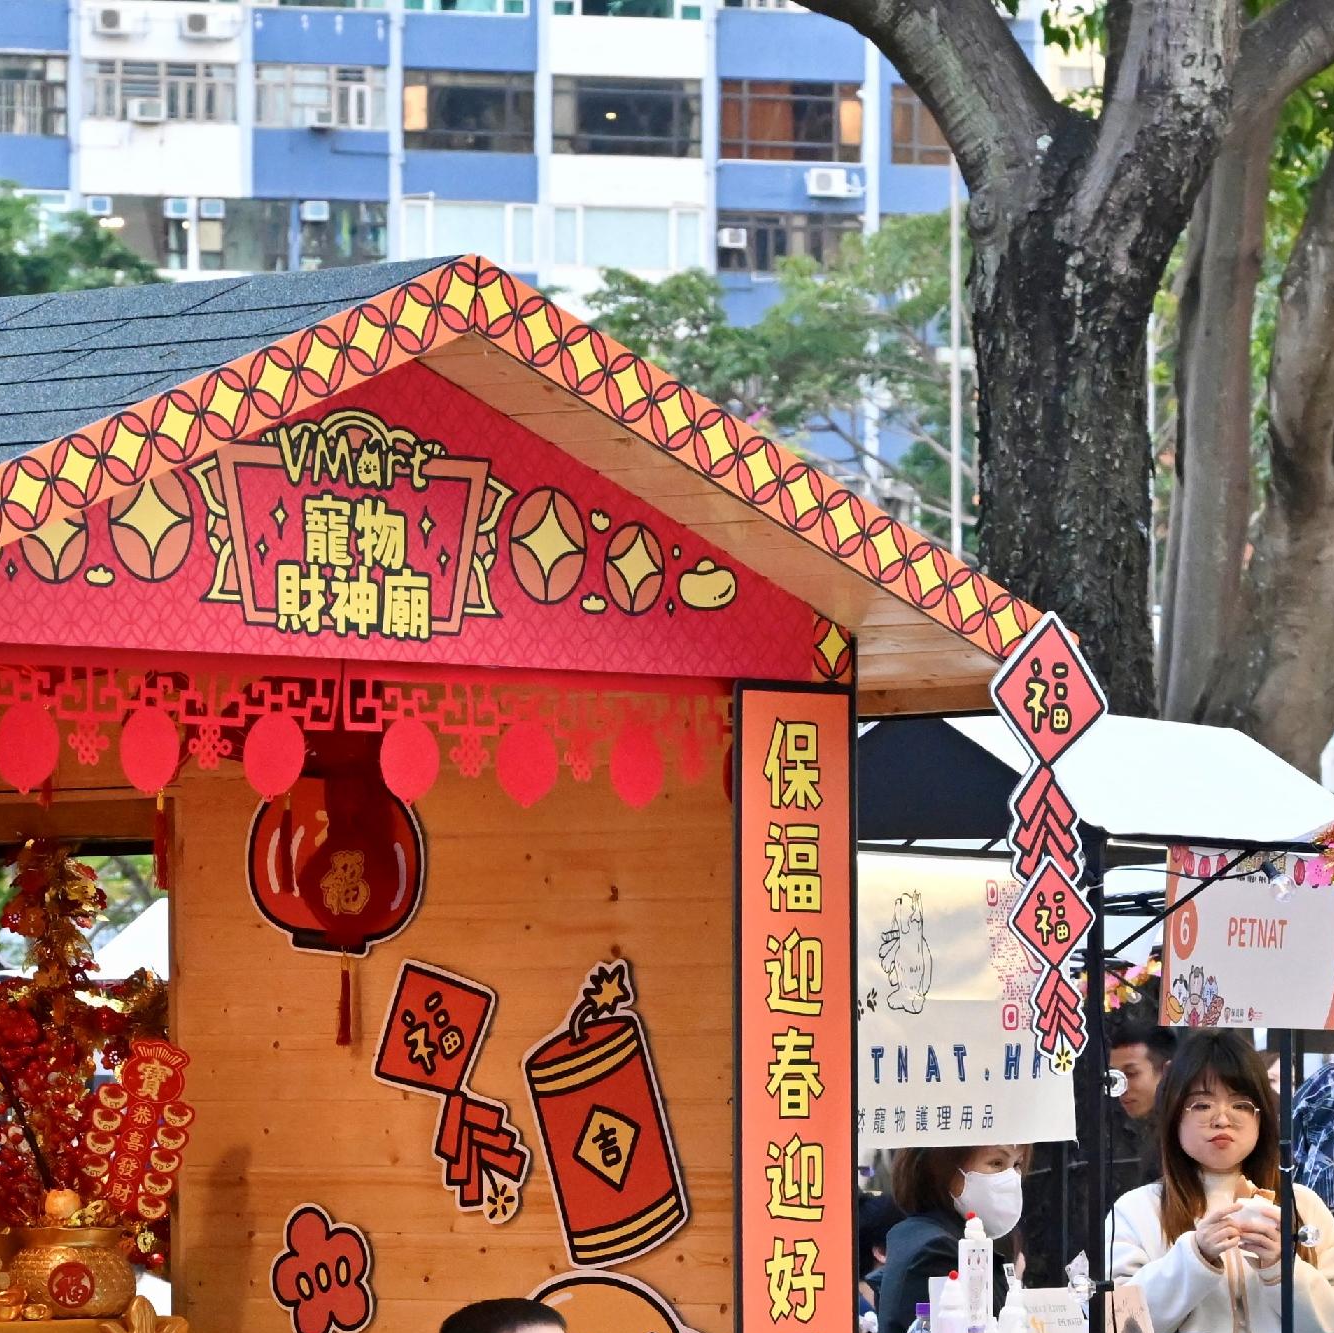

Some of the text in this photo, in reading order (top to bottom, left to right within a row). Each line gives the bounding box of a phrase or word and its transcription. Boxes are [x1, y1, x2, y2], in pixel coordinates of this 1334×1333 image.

[277, 424, 430, 491] VMart
[304, 493, 408, 570] 寵物
[276, 562, 433, 640] 財神廟
[1024, 658, 1073, 735] 福
[320, 850, 371, 916] 福
[1035, 891, 1072, 946] 福
[1180, 911, 1190, 945] 6
[1227, 916, 1288, 950] PETNAT
[402, 991, 466, 1075] 福
[138, 1058, 174, 1102] 寶
[108, 1104, 155, 1205] 恭喜發財
[592, 1121, 621, 1169] 吉
